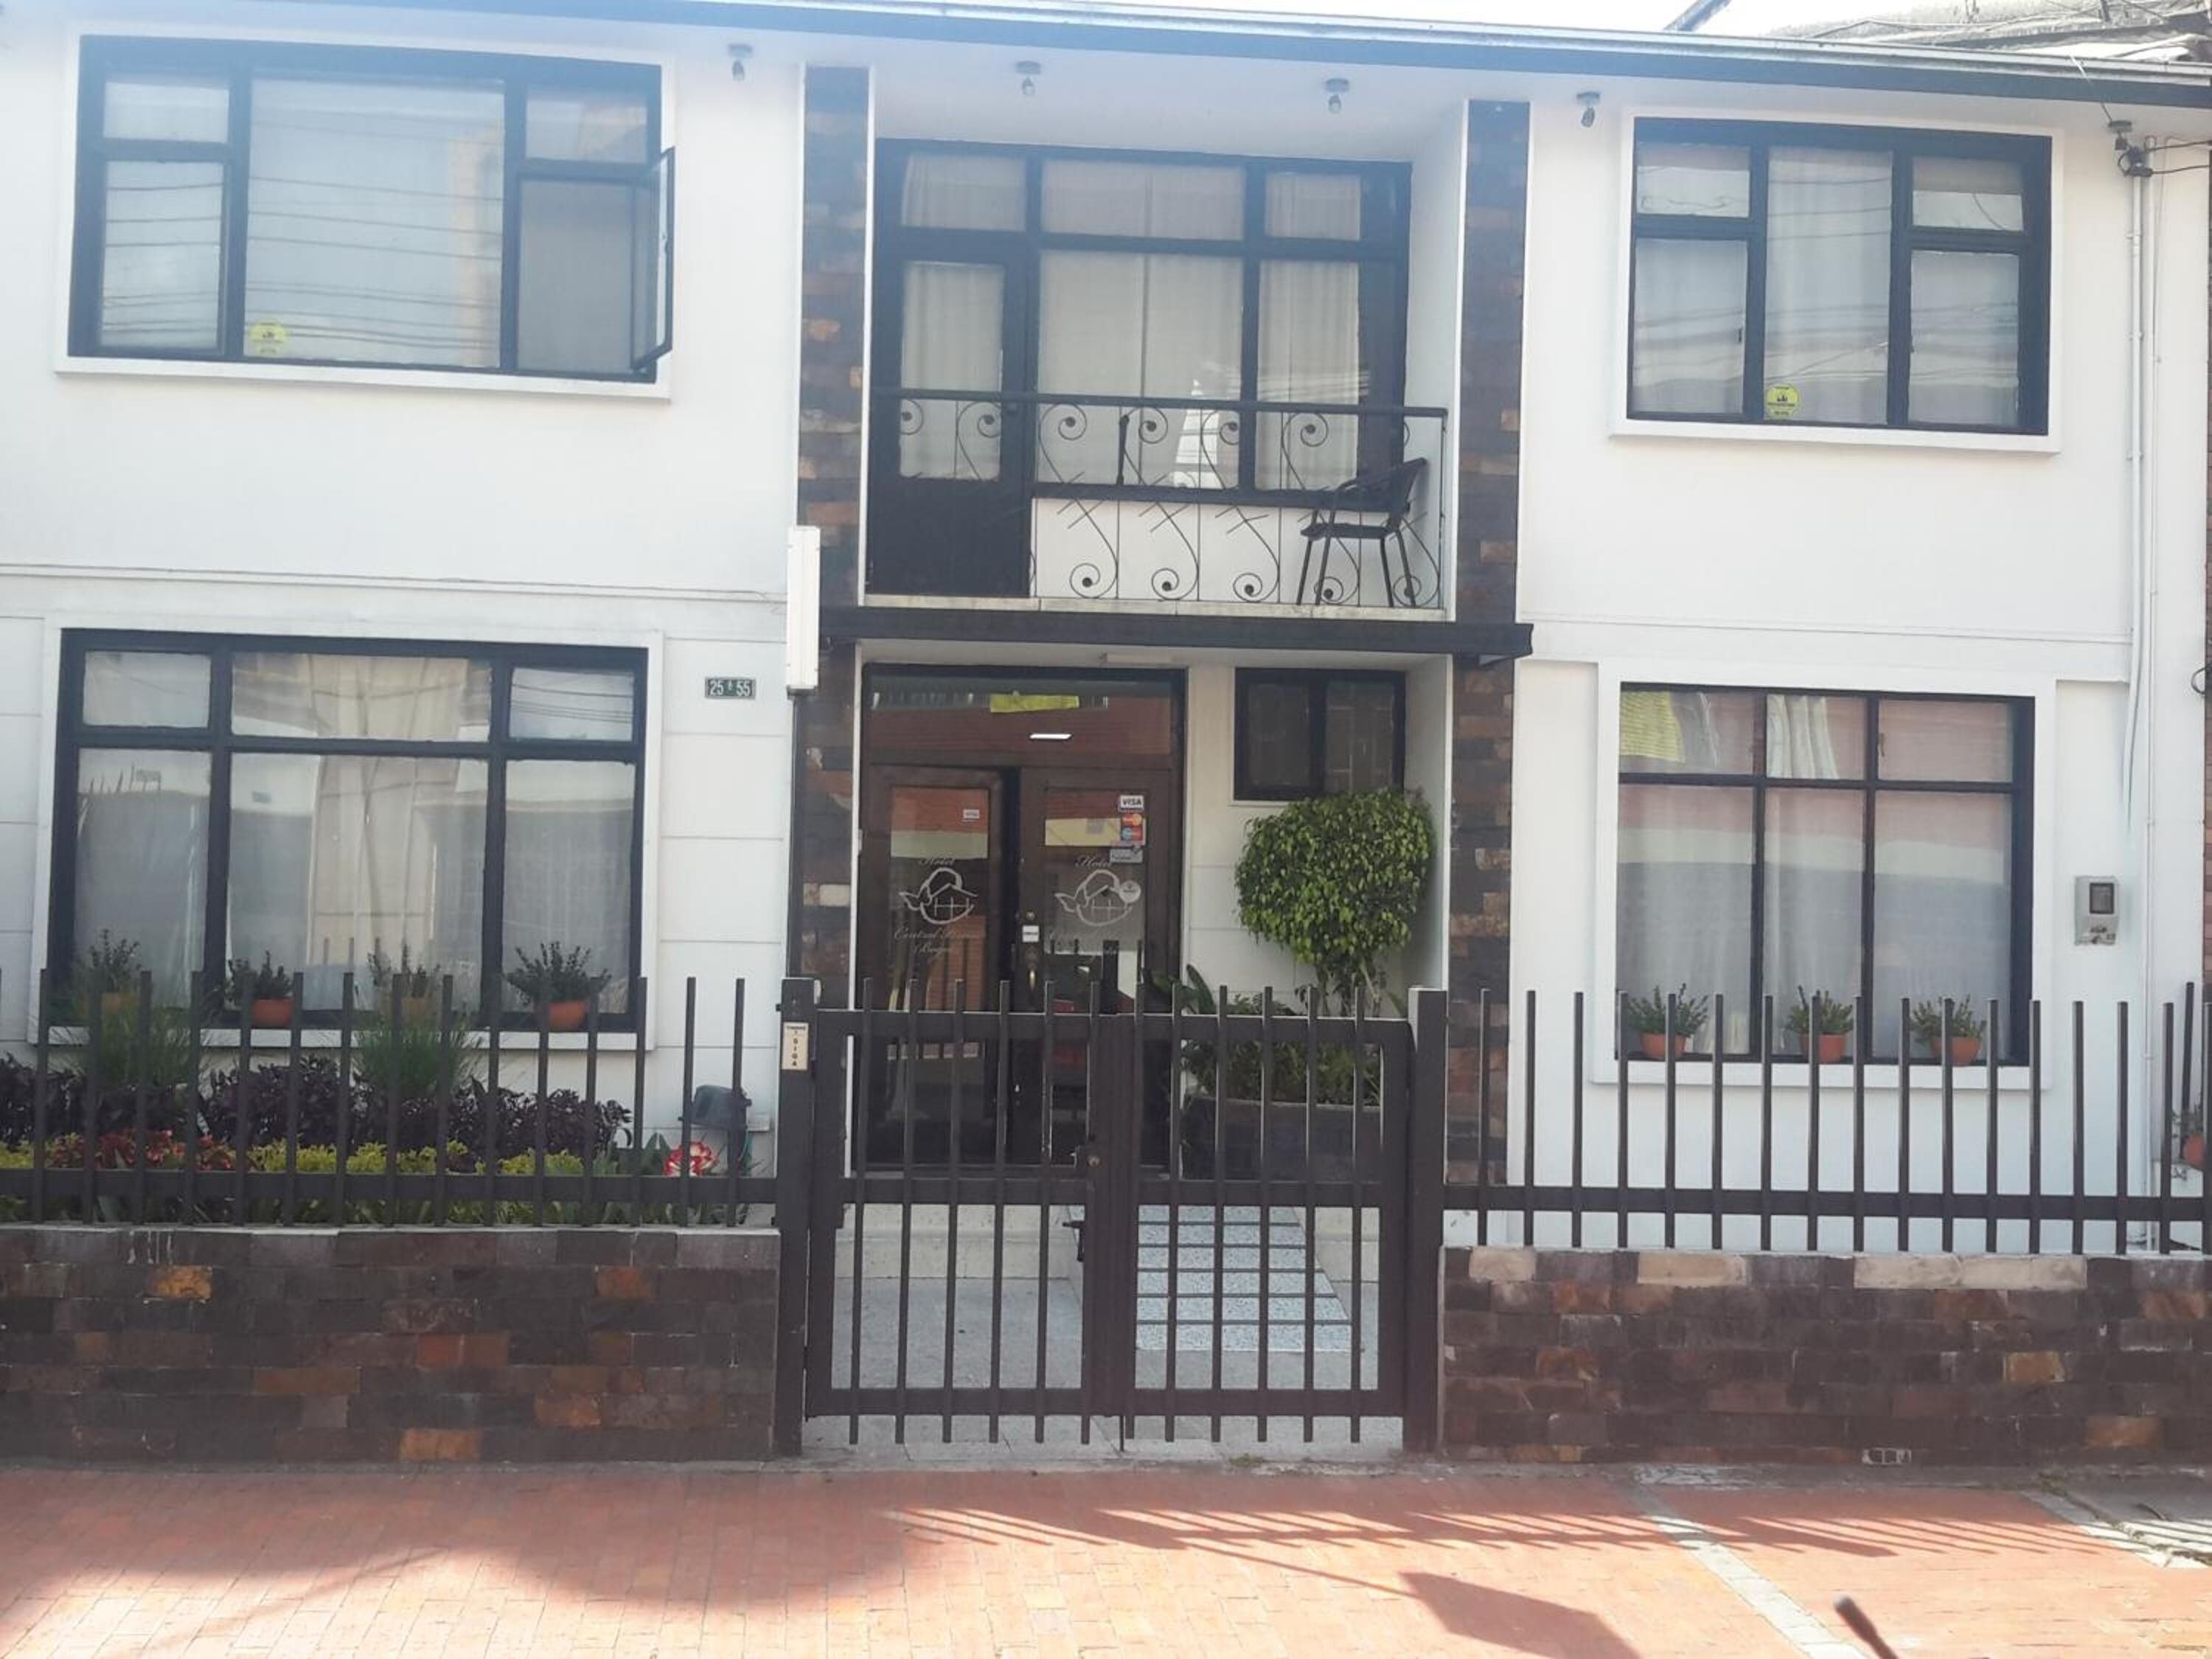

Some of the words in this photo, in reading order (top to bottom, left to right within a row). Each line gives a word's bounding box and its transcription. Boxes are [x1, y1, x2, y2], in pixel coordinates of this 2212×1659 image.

[709, 680, 724, 696] 25
[736, 680, 751, 697] 55
[1121, 798, 1142, 806] VISA
